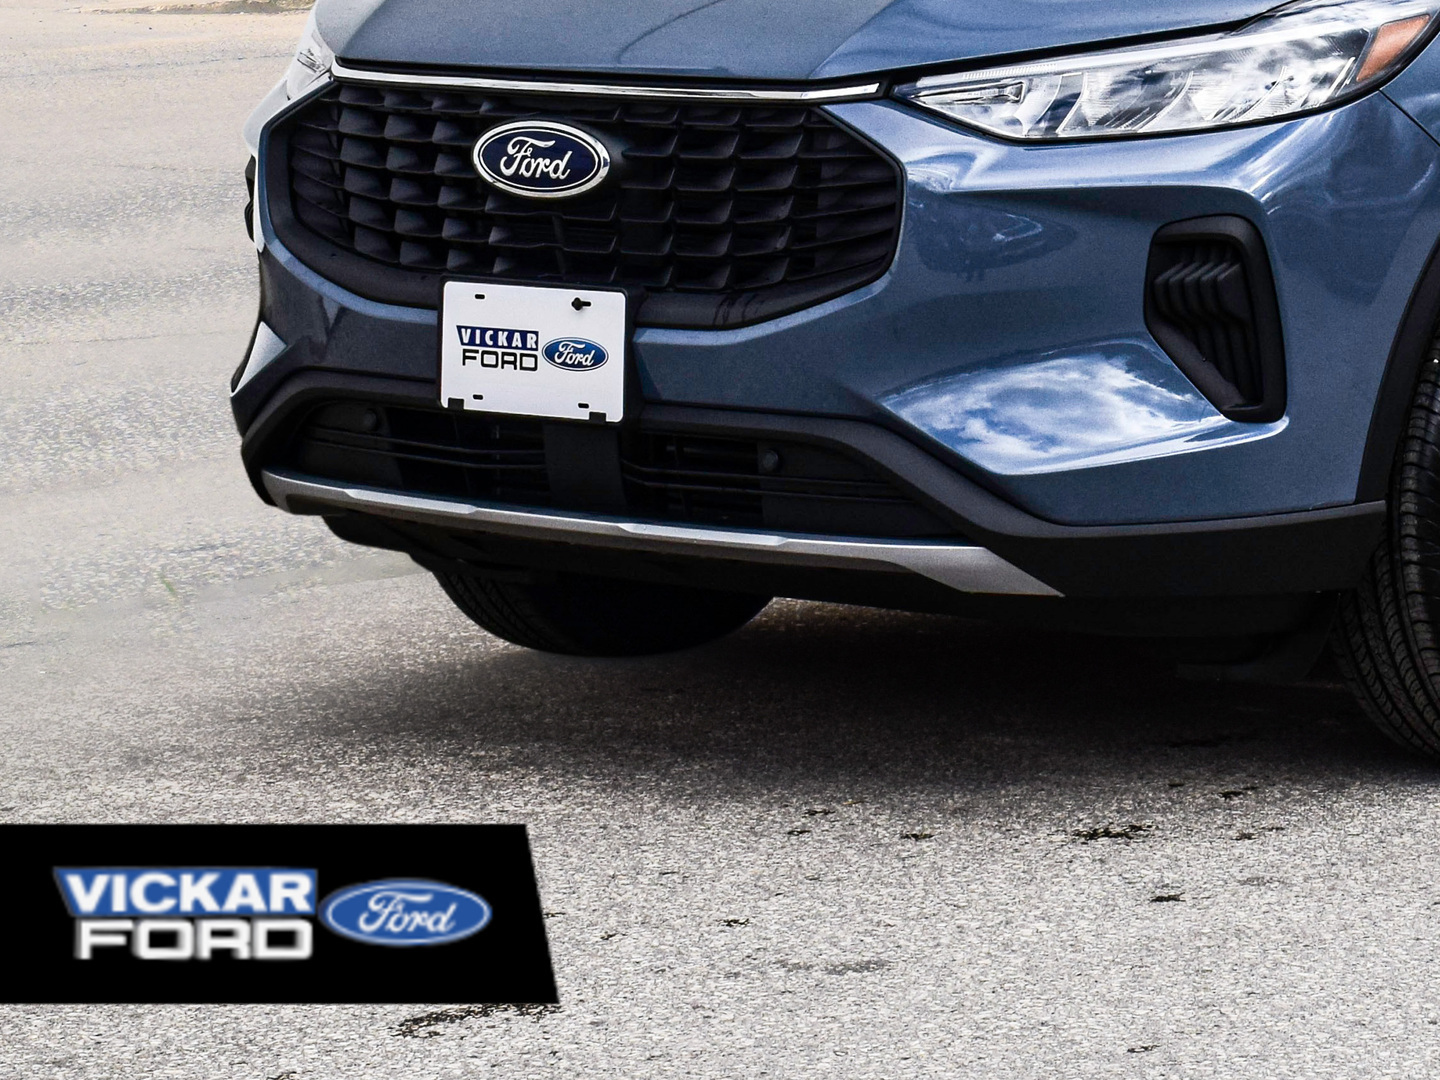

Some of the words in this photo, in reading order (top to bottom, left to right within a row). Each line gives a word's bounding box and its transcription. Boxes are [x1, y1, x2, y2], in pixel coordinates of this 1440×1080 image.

[500, 135, 573, 180] Ford
[460, 326, 538, 350] VICKAR
[462, 348, 539, 372] FORD
[553, 340, 596, 367] Ford
